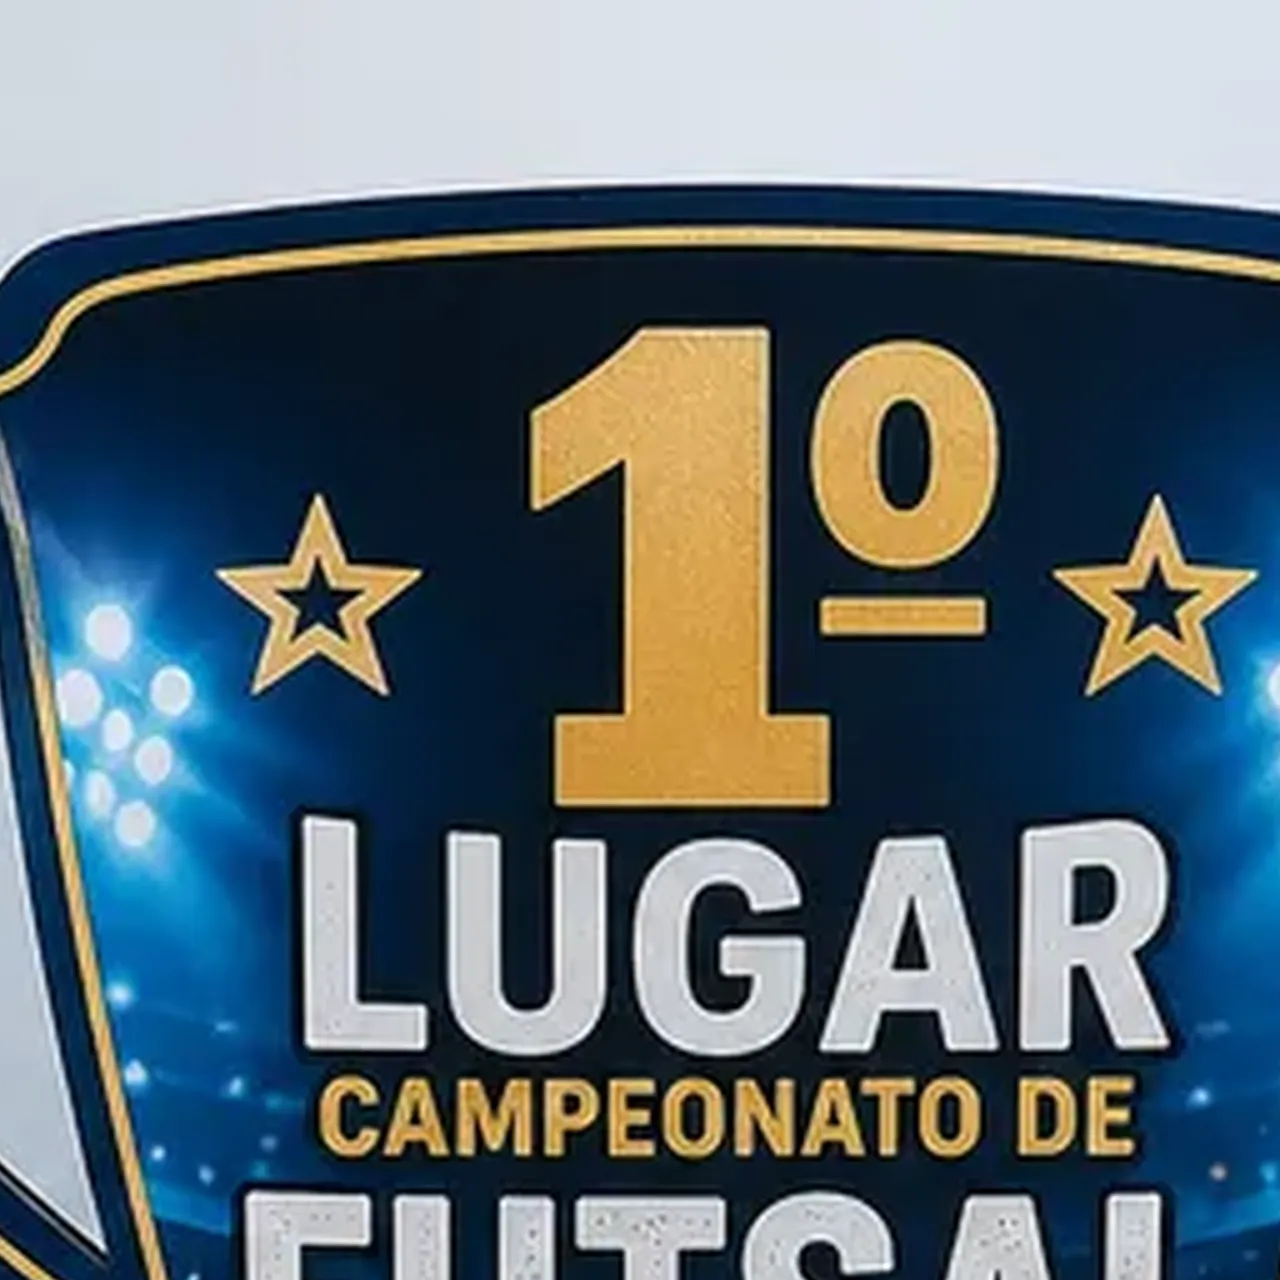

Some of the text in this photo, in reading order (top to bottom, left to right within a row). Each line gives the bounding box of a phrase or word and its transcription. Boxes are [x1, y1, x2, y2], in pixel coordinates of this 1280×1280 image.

[300, 813, 1171, 1056] LUGAR
[319, 1075, 1137, 1158] CAMPEONATO DE
